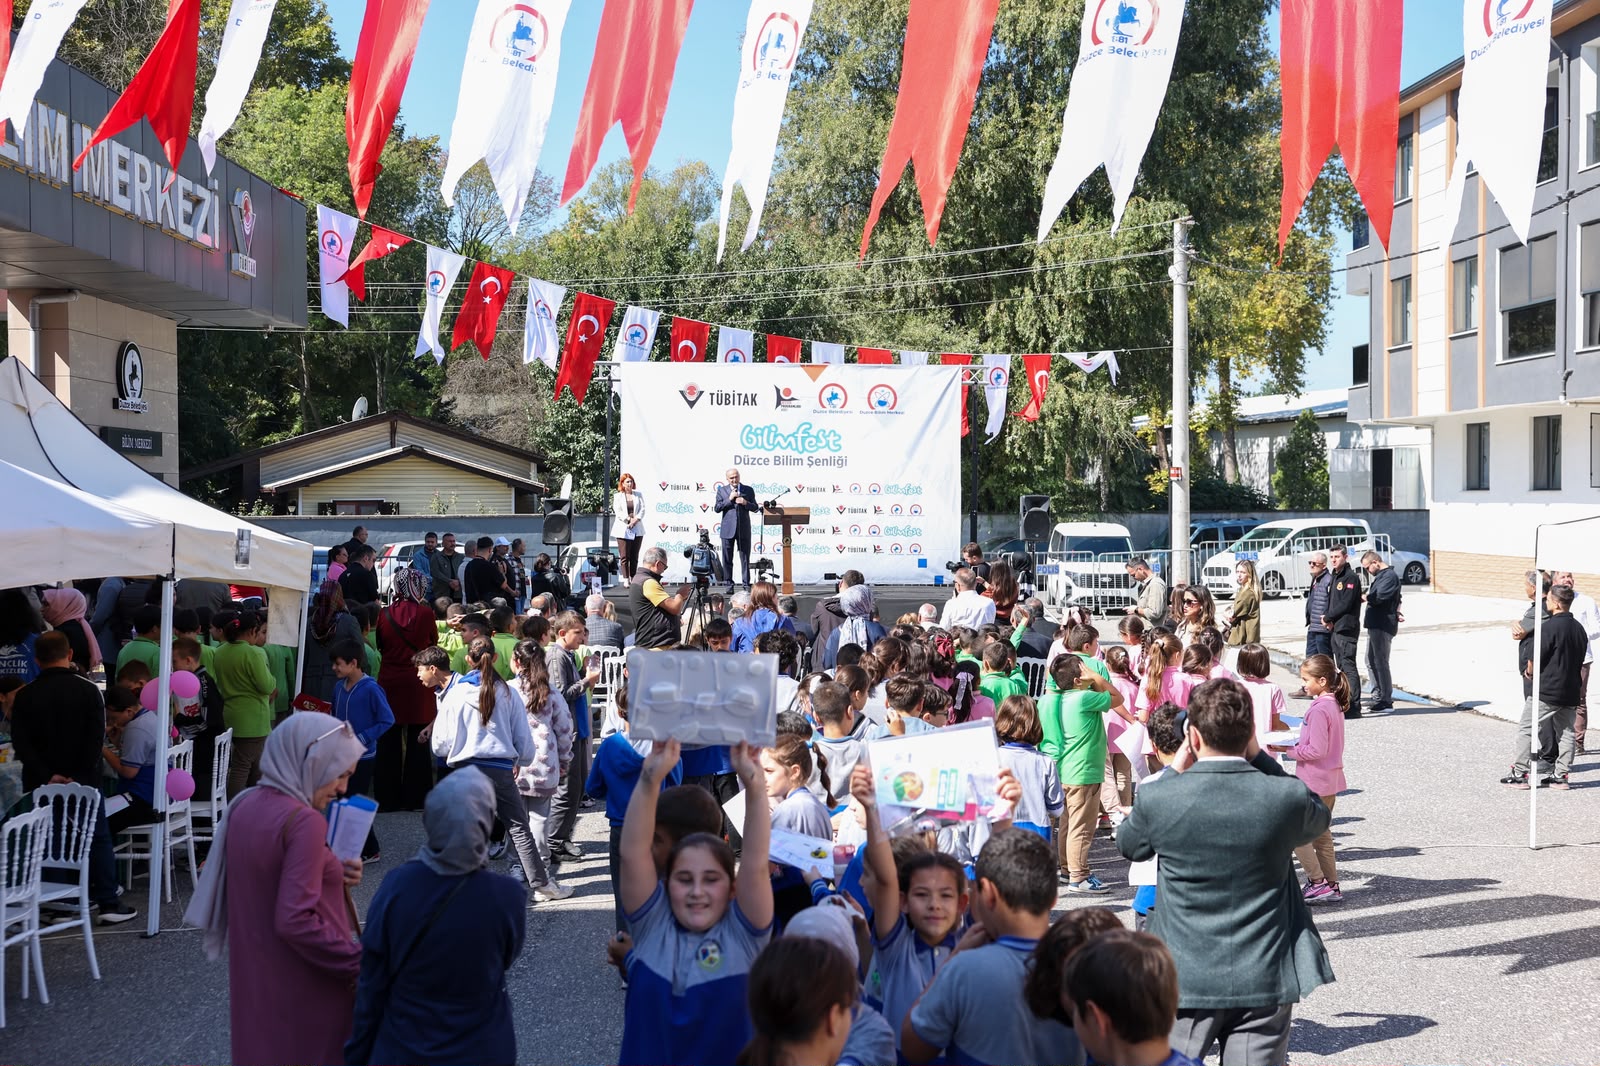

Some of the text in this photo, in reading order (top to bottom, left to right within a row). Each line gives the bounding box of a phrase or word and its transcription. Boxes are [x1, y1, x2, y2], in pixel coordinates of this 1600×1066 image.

[76, 122, 219, 249] MERKEZİ
[709, 390, 758, 406] TÜBİTAK
[740, 422, 842, 454] bilimfest
[734, 455, 848, 469] Düzce Bilim Şenliği
[670, 483, 690, 491] TÜBİTAK
